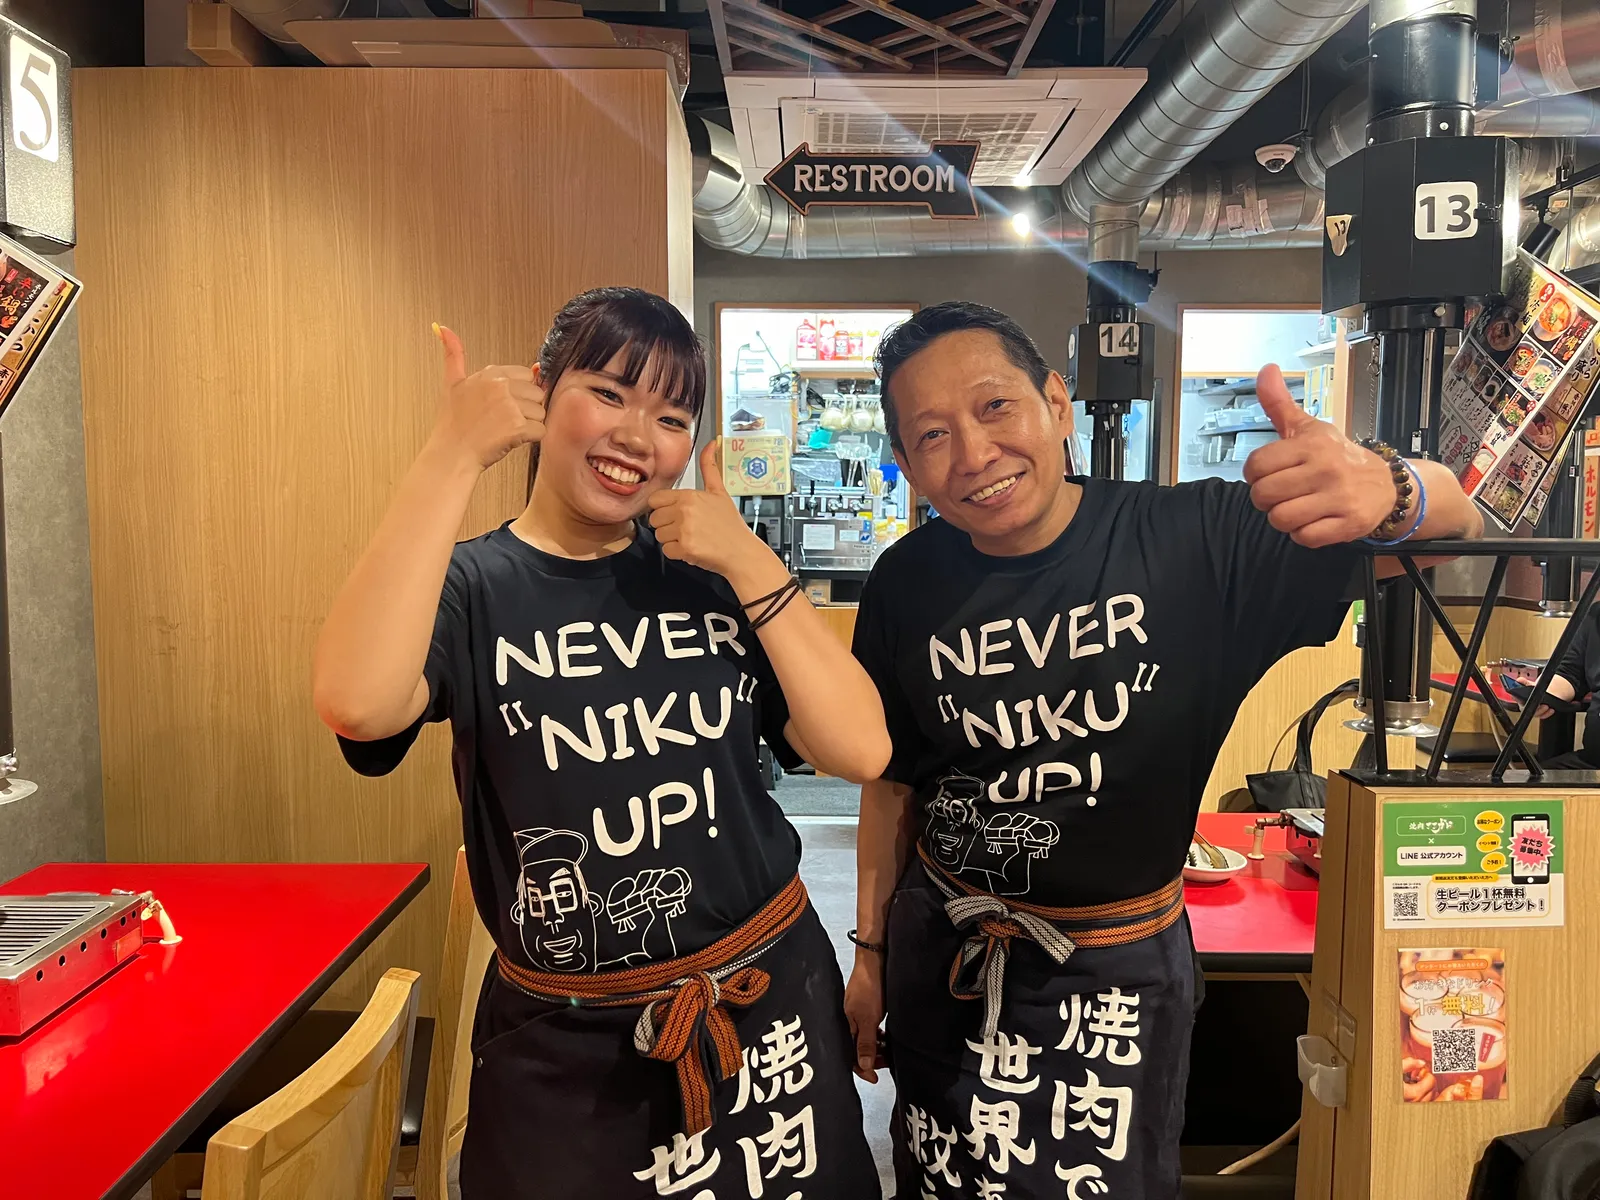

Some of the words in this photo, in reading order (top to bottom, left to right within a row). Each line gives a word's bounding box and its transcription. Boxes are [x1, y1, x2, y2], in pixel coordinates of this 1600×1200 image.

[19, 52, 52, 151] 5
[792, 164, 956, 193] RESTROOM
[1419, 194, 1472, 233] 13
[1101, 326, 1137, 352] 14
[1585, 465, 1596, 532] ホルモン
[495, 612, 746, 686] NEVER
[929, 593, 1148, 681] NEVER
[592, 767, 718, 857] UP!
[988, 752, 1102, 807] UP!
[1400, 852, 1418, 860] LINE
[1521, 837, 1543, 847] 友だち
[1436, 900, 1546, 913] クーポンプレゼント！
[728, 1014, 817, 1200] 焼肉
[1051, 986, 1142, 1200] 焼肉で
[633, 1125, 721, 1200] 世
